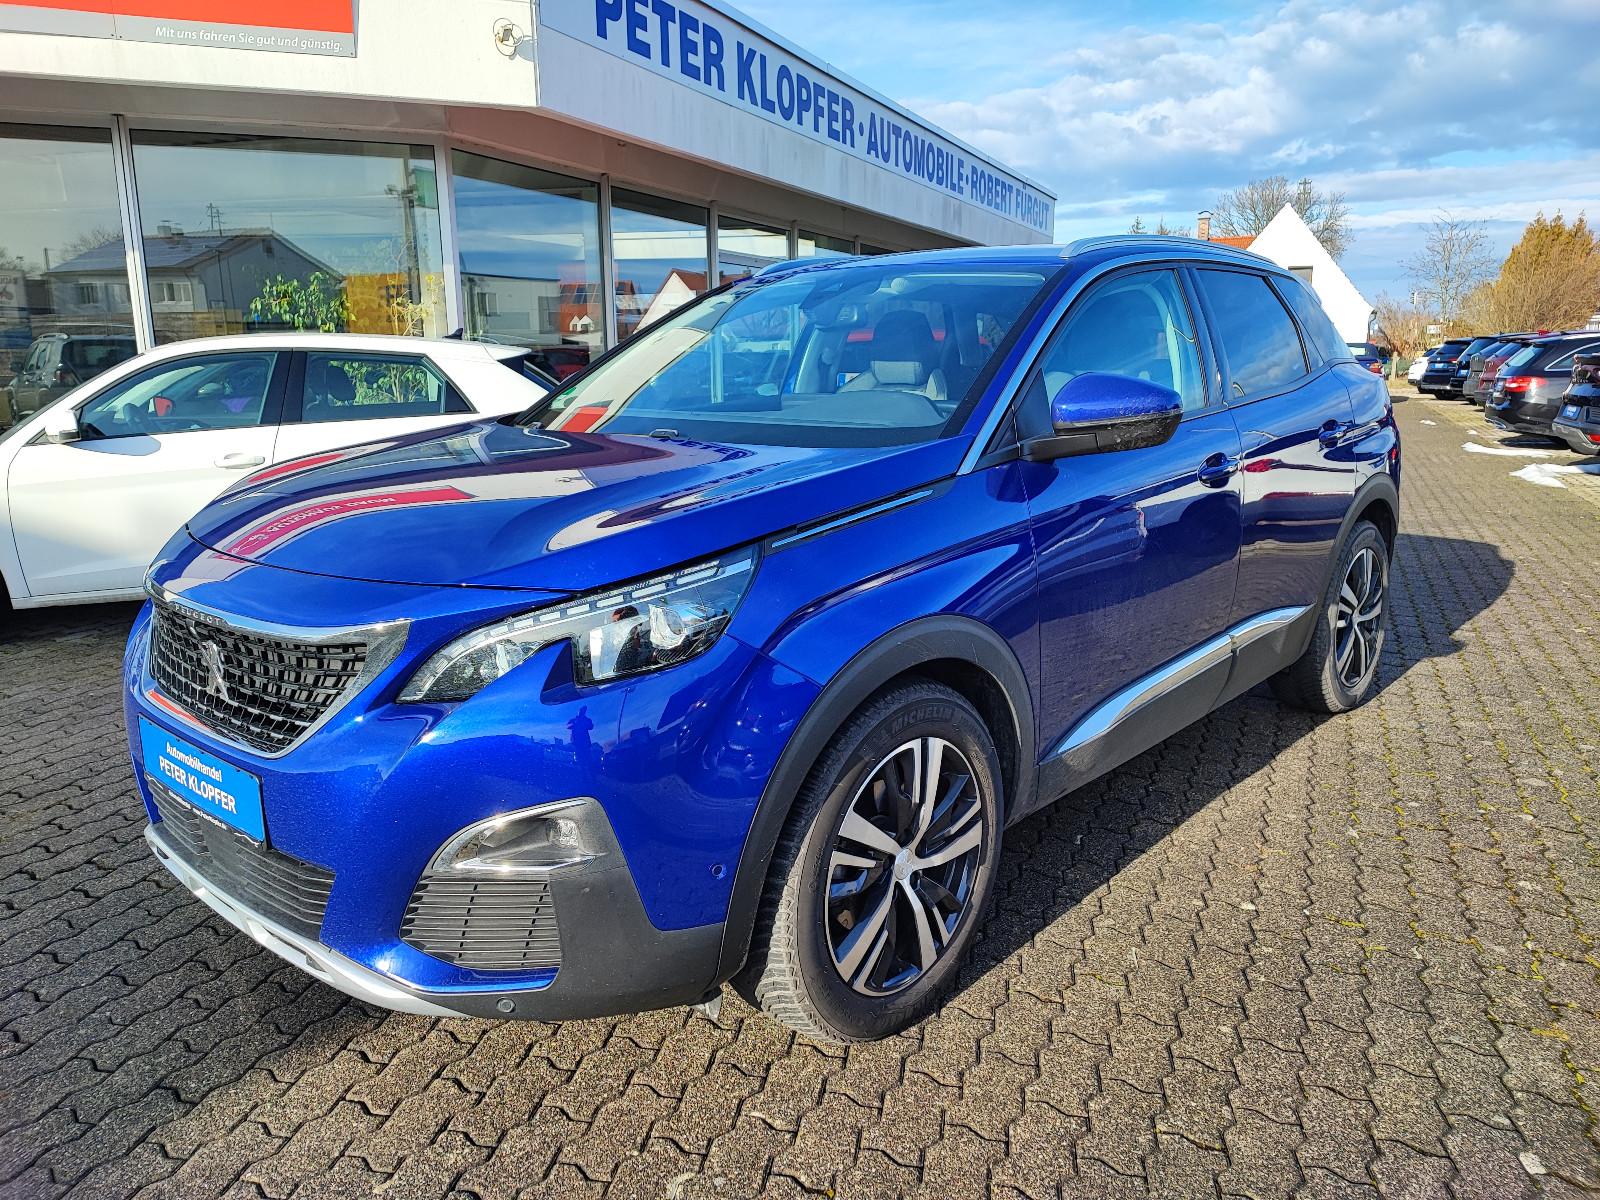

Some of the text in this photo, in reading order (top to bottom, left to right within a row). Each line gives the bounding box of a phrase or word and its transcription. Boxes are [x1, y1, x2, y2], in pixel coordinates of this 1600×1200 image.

[155, 26, 343, 52] Mit uns fahren Sie gut und günstig.
[596, 0, 1050, 231] PETER KLOPFER AUTOMOBILE ROBERT FÜRGUT
[174, 603, 221, 626] PEUGEOT
[892, 706, 956, 734] MICHELIN
[166, 741, 223, 783] Automobilhandel
[159, 755, 188, 787] PETER
[188, 773, 238, 815] KLOPFER
